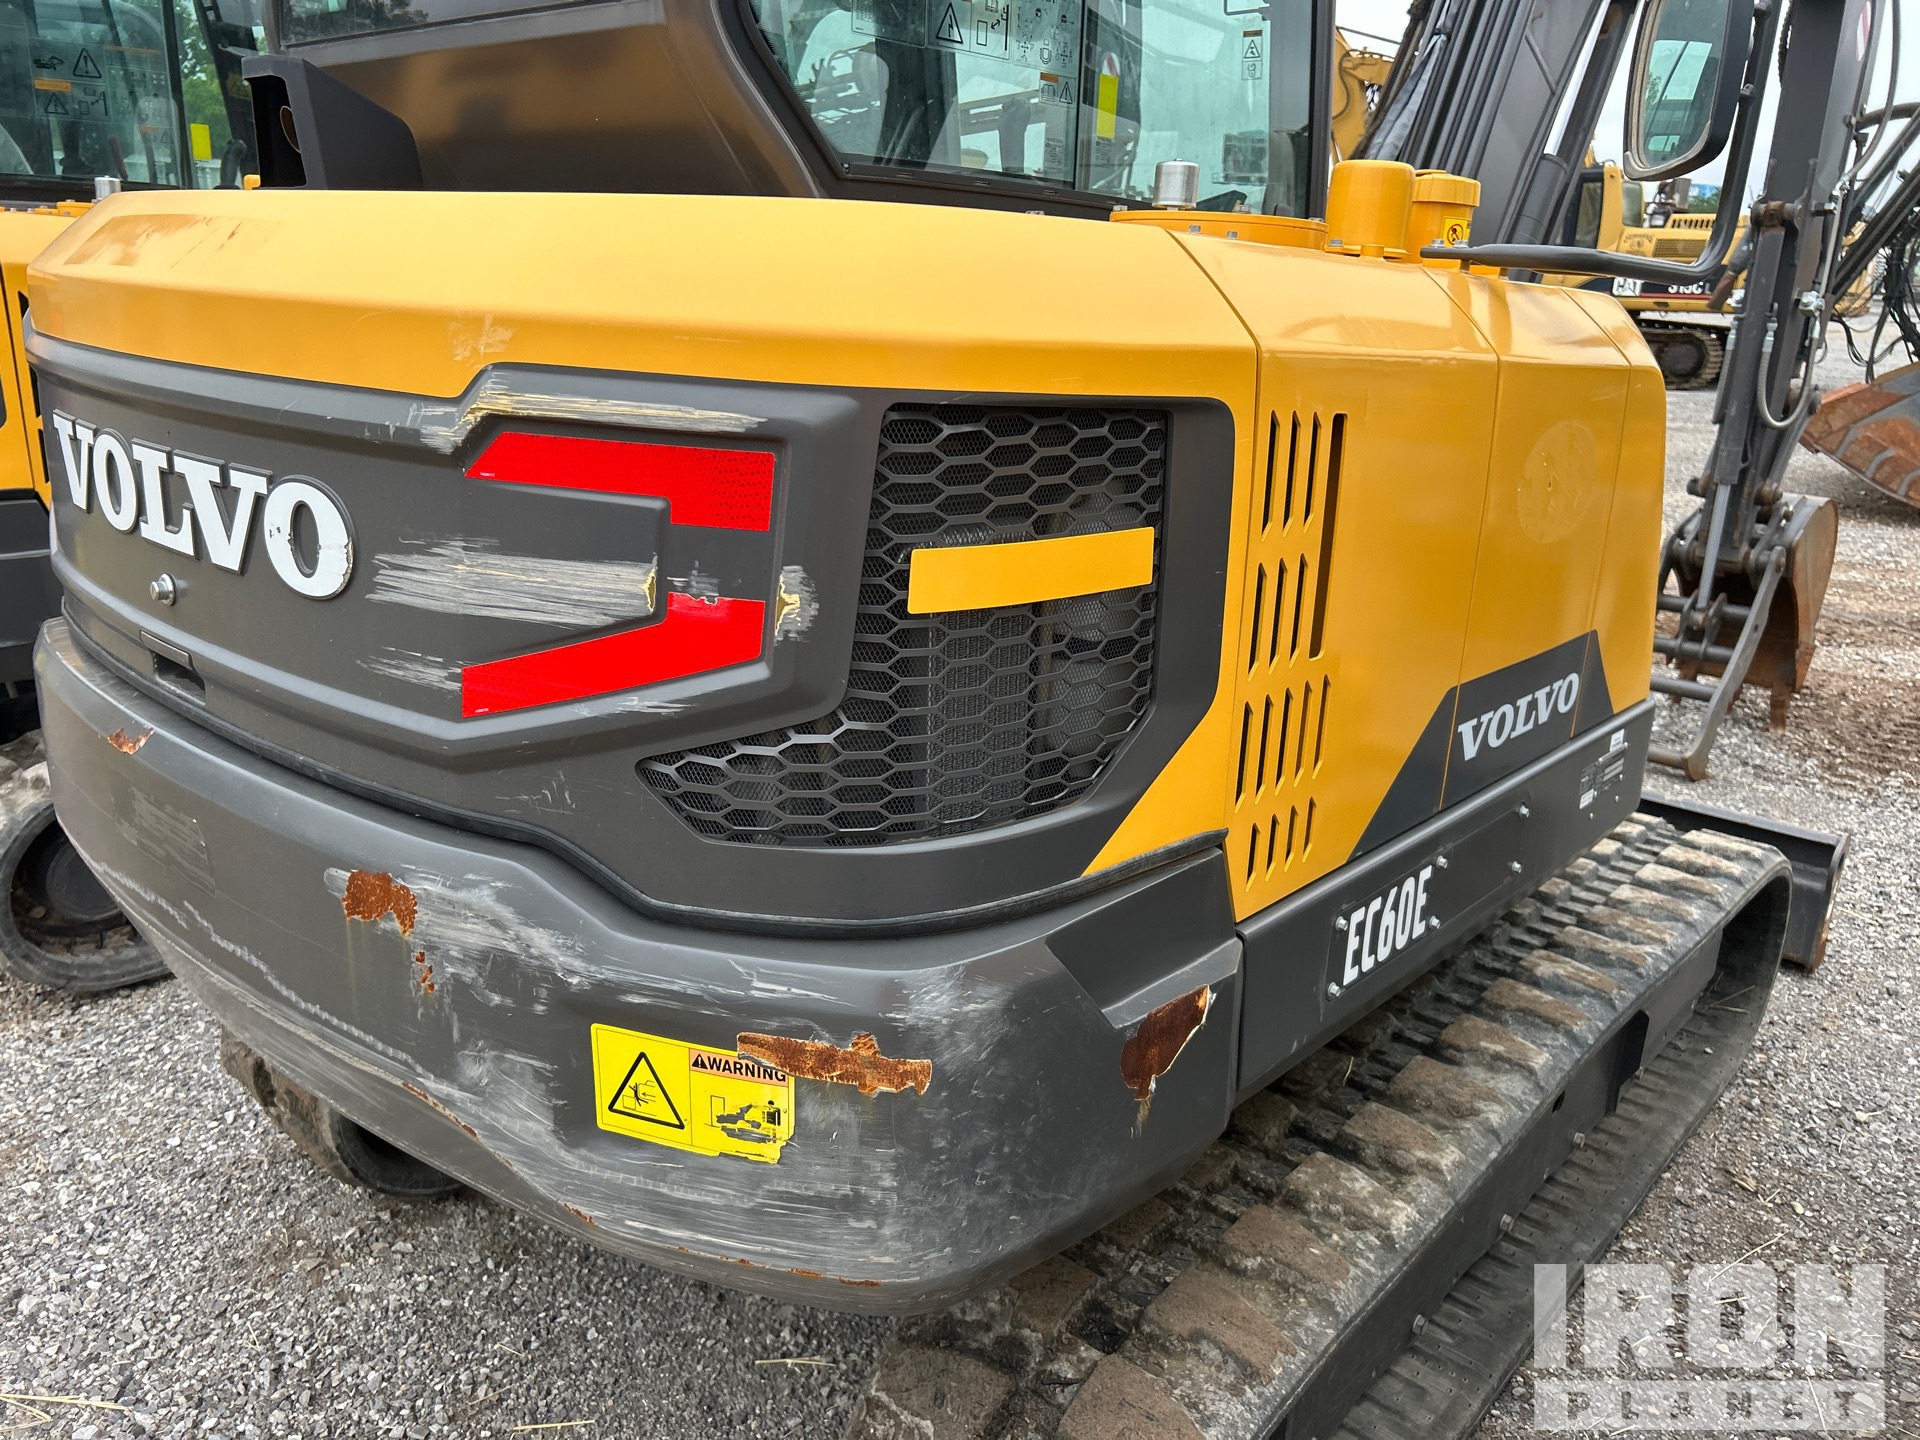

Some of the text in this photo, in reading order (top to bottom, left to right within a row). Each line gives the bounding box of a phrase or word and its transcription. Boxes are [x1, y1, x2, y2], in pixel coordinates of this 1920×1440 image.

[1612, 277, 1644, 296] CAT
[52, 411, 354, 599] VOLVO
[1457, 672, 1580, 761] VOLVO
[1342, 865, 1432, 986] EC60E
[707, 1056, 786, 1082] WARNING
